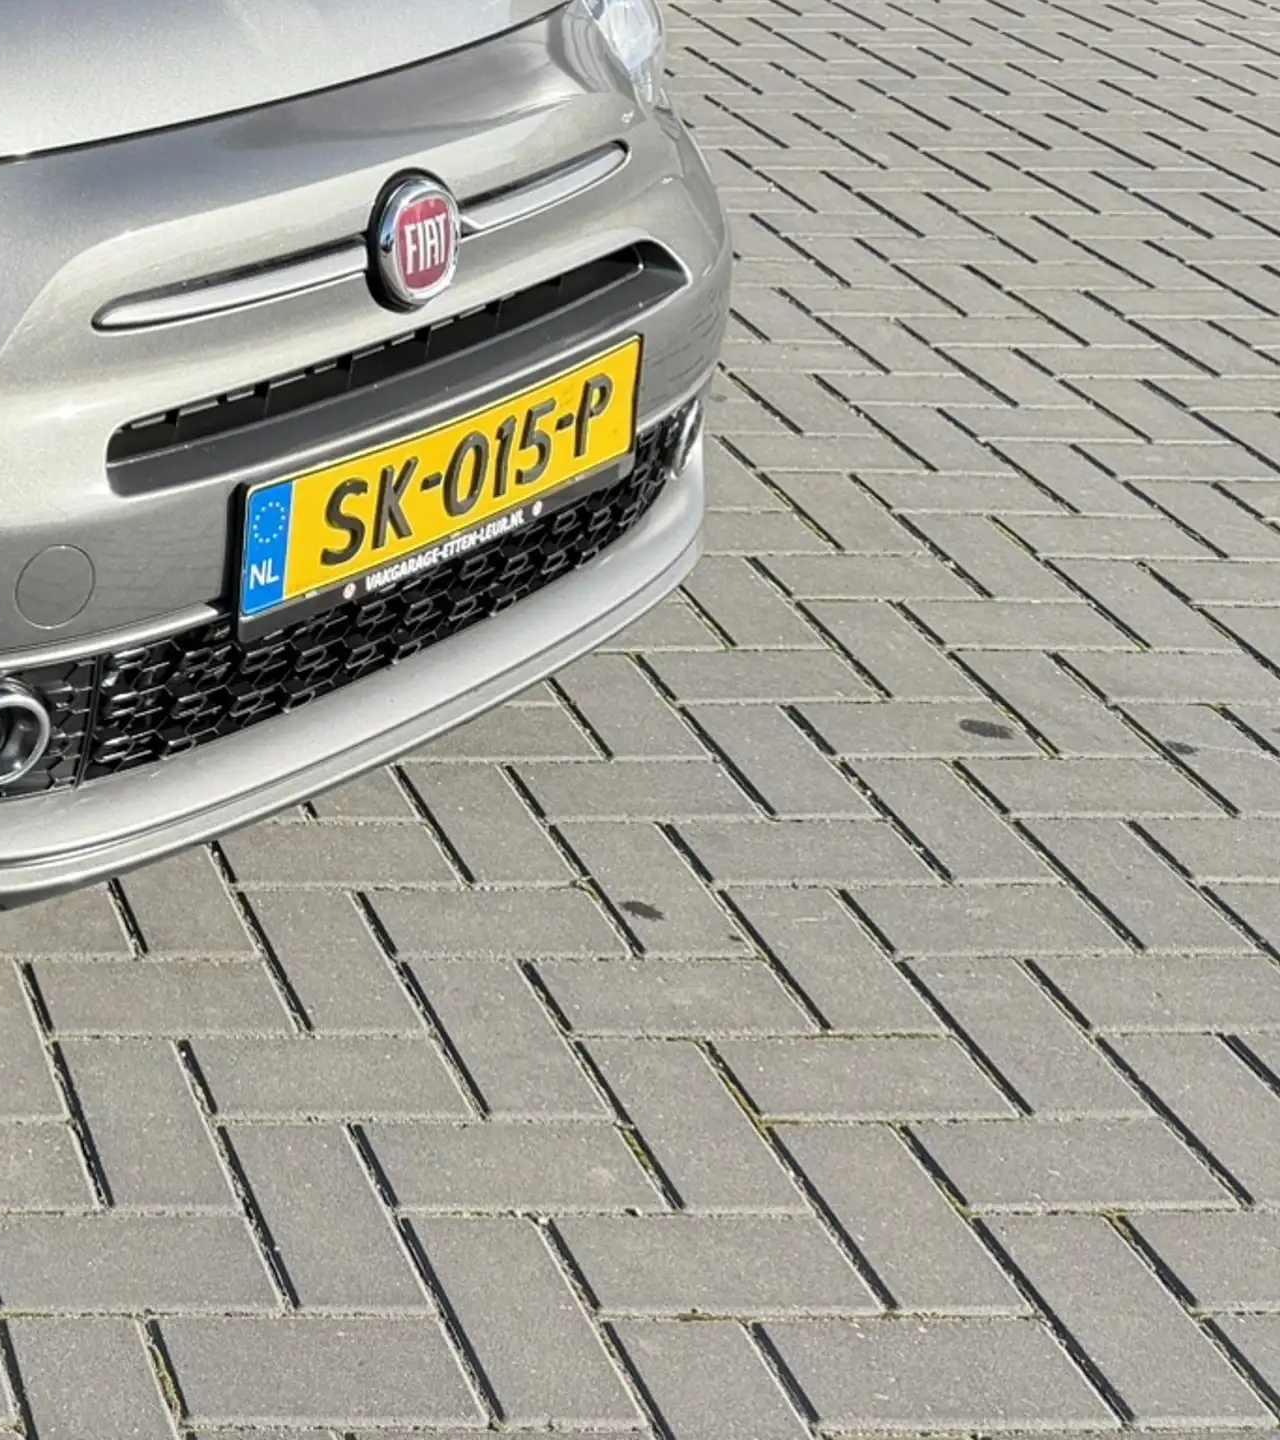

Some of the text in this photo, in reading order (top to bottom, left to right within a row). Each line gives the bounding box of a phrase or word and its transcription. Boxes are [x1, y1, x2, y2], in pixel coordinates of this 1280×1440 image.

[404, 213, 447, 275] FIAT
[320, 373, 613, 568] SK-015-P
[248, 561, 280, 590] NL
